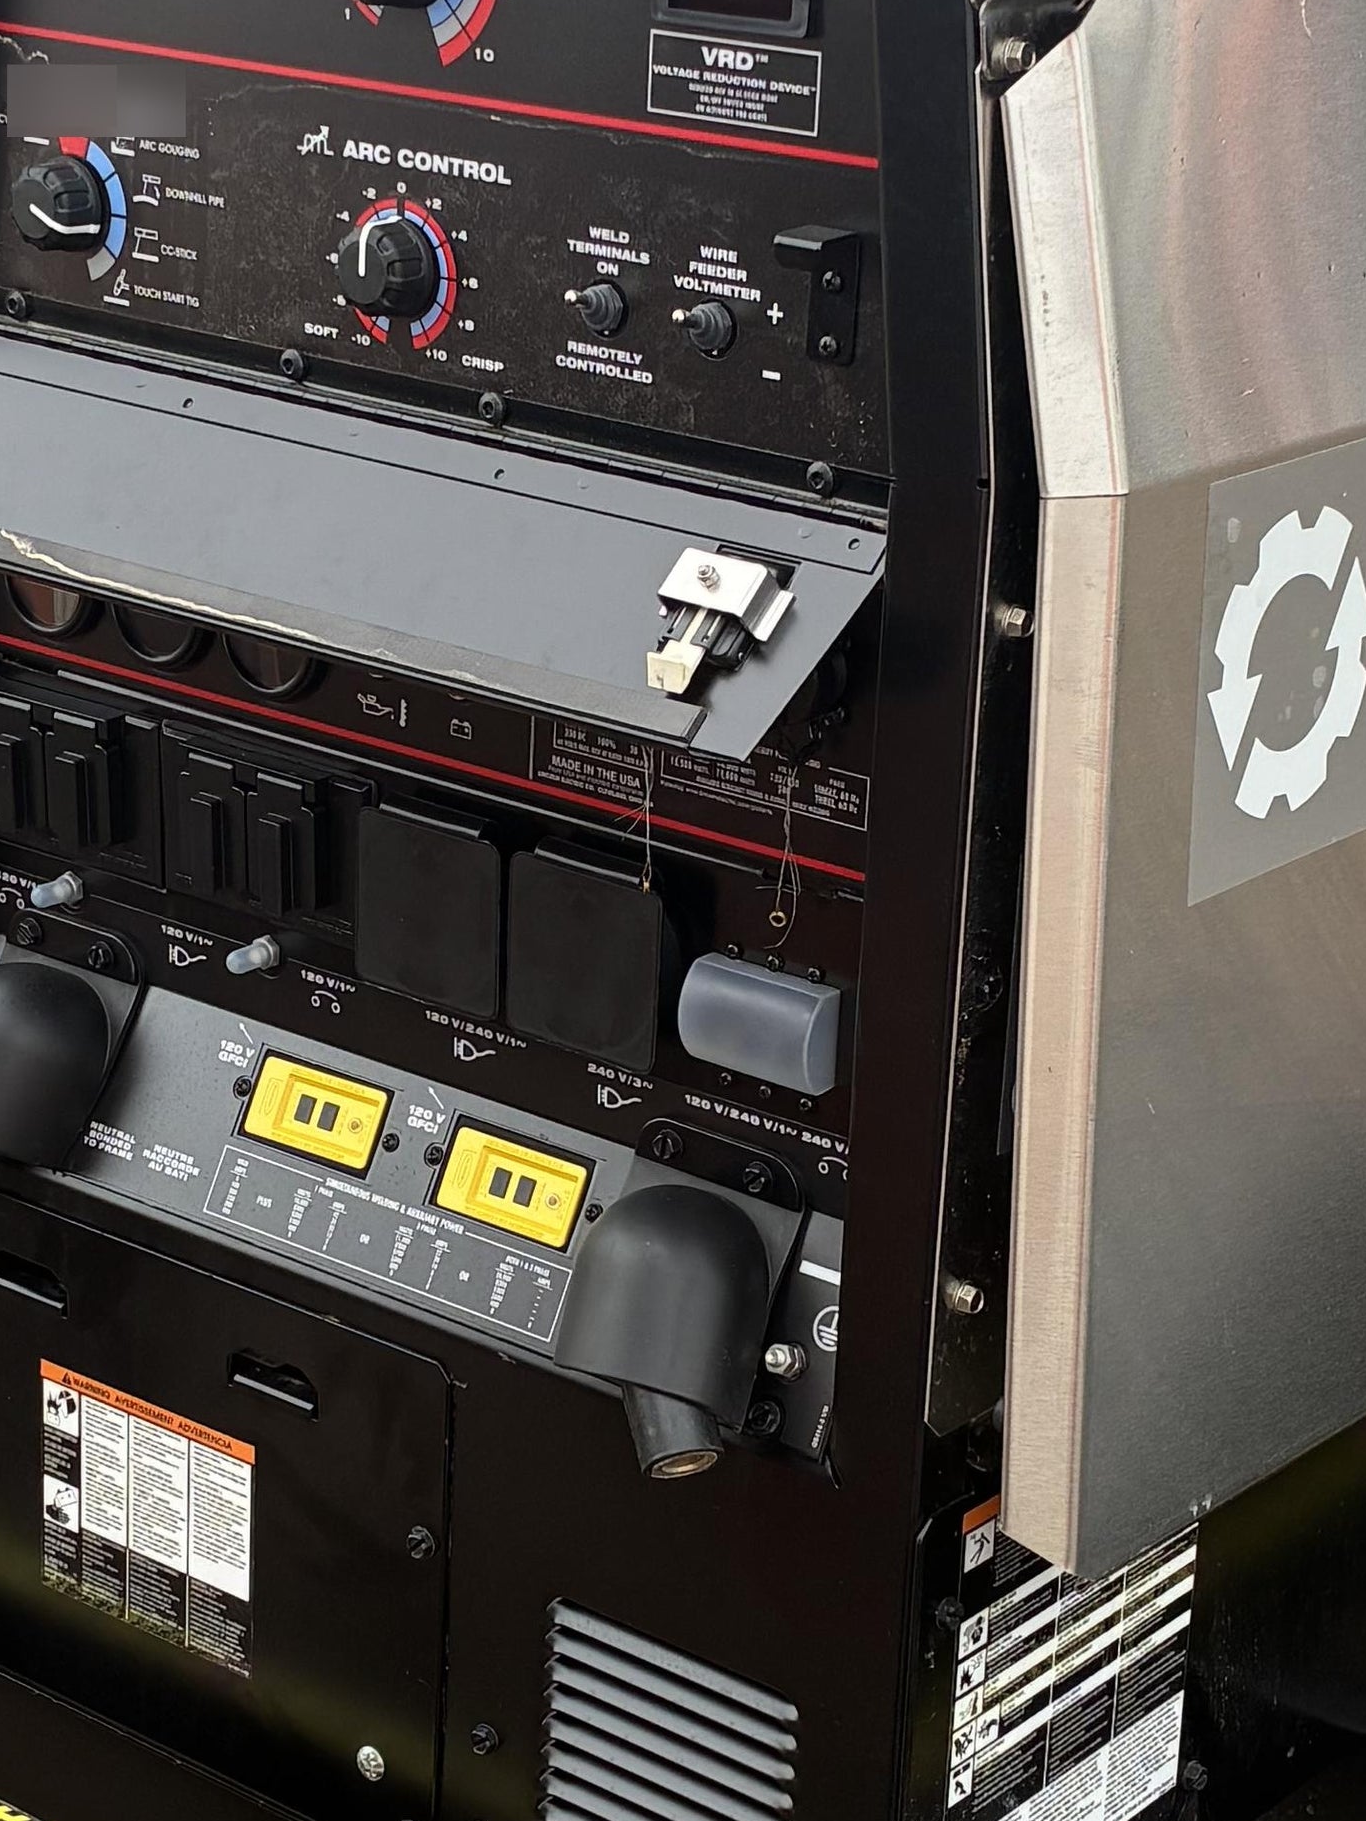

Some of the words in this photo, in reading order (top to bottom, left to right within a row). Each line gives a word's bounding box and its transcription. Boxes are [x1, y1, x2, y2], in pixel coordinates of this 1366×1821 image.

[344, 8, 351, 20] 1
[475, 47, 495, 63] 10
[653, 64, 700, 81] VOLTAGE
[703, 71, 766, 91] REDUCTION
[139, 139, 157, 152] ARC
[158, 142, 200, 160] GOUGING
[342, 139, 391, 165] ARC
[397, 148, 513, 186] CONTROL
[165, 187, 206, 205] DOWNHILL
[208, 195, 225, 208] PIPE
[588, 226, 630, 245] WELD
[160, 244, 198, 261] CC-STICK
[567, 239, 651, 265] TERMINALS
[699, 245, 738, 264] WIRE
[596, 260, 619, 277] ON
[688, 260, 748, 283] FEEDER
[133, 284, 162, 301] TOUCH
[162, 289, 185, 306] START
[185, 294, 200, 308] TIG
[673, 274, 761, 303] VOLTMETER
[303, 322, 339, 340] SOFT
[351, 333, 371, 347] -10
[567, 340, 643, 365] REMOTELY
[461, 354, 505, 373] CRISP
[555, 354, 653, 385] CONTROLLED
[551, 754, 581, 774] MADE
[584, 762, 595, 777] IN
[597, 765, 618, 783] THE
[619, 769, 641, 789] USA
[160, 924, 184, 940] 120
[300, 968, 325, 985] 120
[425, 1009, 449, 1026] 120
[450, 1016, 493, 1039] V/240
[220, 1039, 243, 1055] 120
[218, 1050, 248, 1068] GFCI
[587, 1062, 617, 1081] 240
[409, 1103, 433, 1120] 120
[436, 1113, 446, 1125] V
[684, 1093, 713, 1112] 120
[714, 1101, 761, 1128] V/240
[801, 1130, 832, 1150] 240
[90, 1120, 136, 1144] NEUTRAL
[407, 1117, 439, 1134] GFCI
[84, 1136, 97, 1147] TO
[98, 1142, 134, 1161] FRAME
[89, 1129, 132, 1151] BONDED
[143, 1149, 201, 1177] RACCORDE
[153, 1144, 194, 1165] NEUTRE
[148, 1160, 163, 1172] AU
[256, 1195, 272, 1208] PLUS
[325, 1177, 371, 1201] SIMULTANEOUS
[371, 1193, 400, 1213] WELDING
[406, 1206, 439, 1227] AUXILIARY
[439, 1217, 465, 1234] POWER
[359, 1233, 371, 1244] OR
[459, 1270, 470, 1281] OR
[72, 1378, 111, 1401] WARNING
[115, 1395, 174, 1427] AVERTISSEMENT
[177, 1419, 233, 1453] ADVERTENCIA
